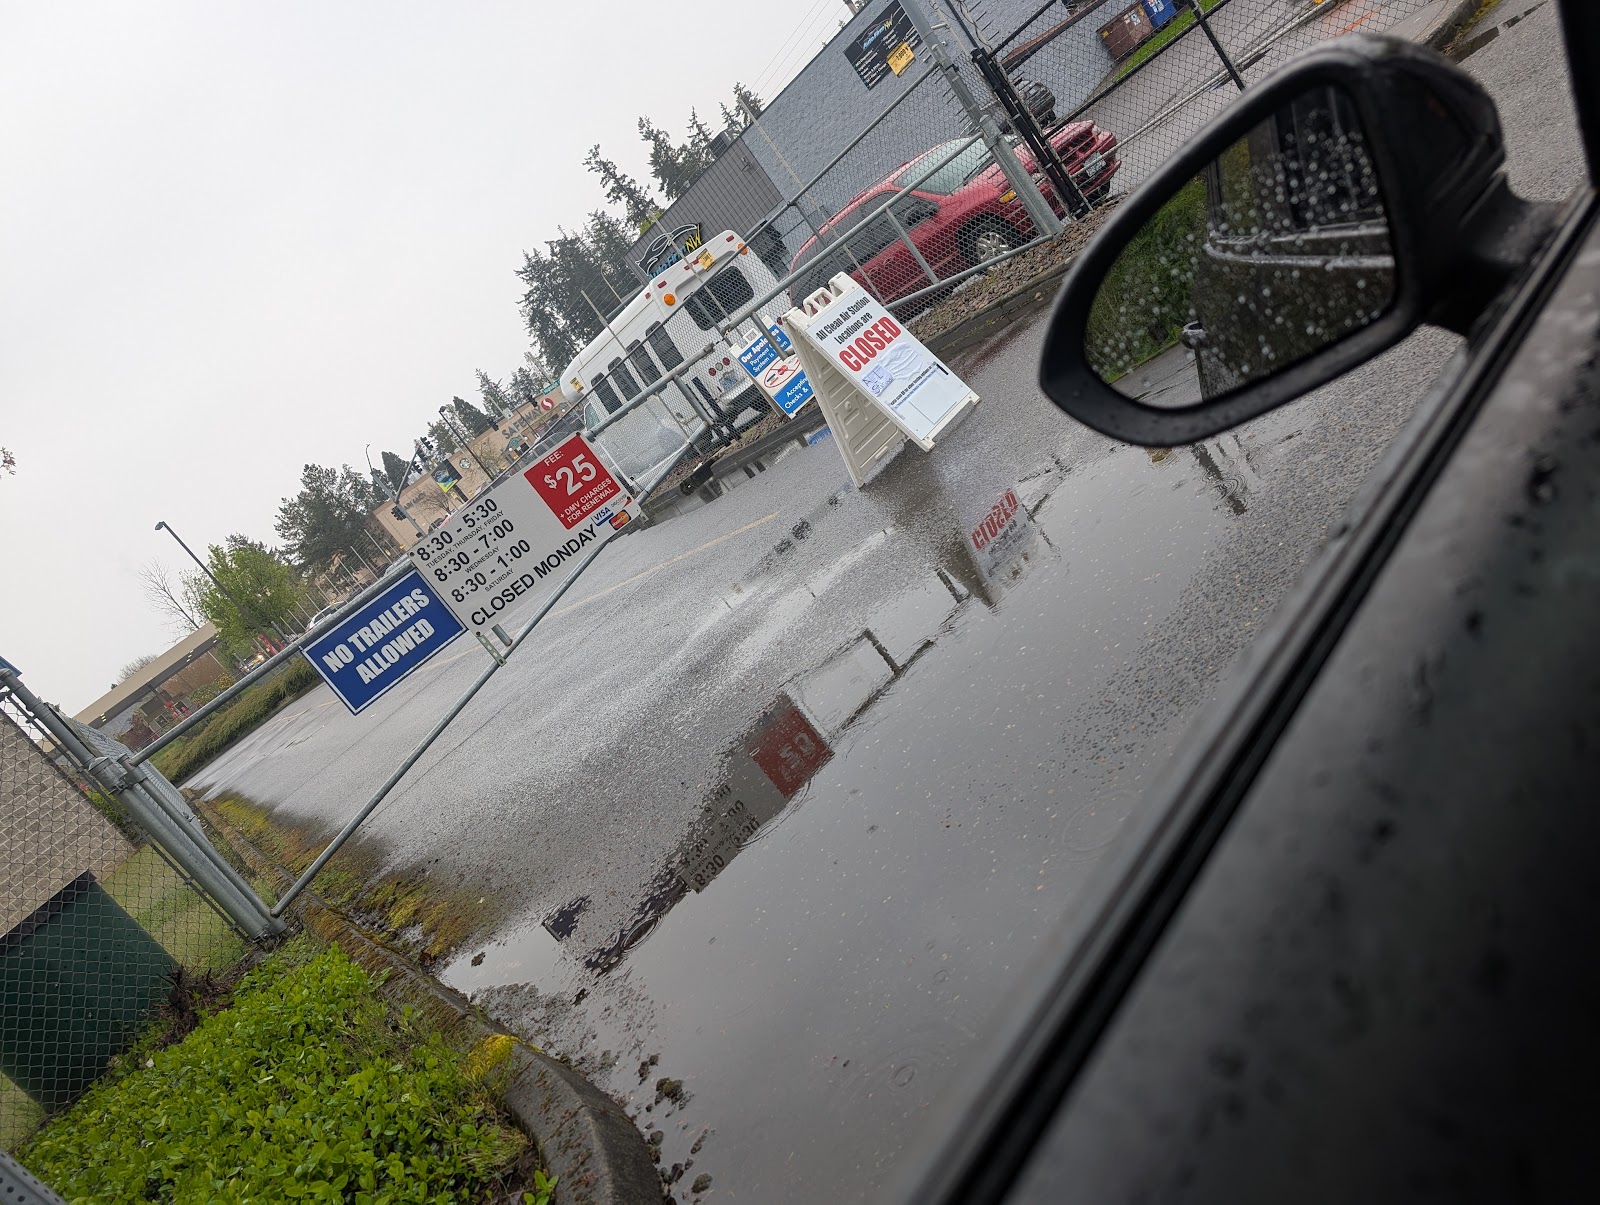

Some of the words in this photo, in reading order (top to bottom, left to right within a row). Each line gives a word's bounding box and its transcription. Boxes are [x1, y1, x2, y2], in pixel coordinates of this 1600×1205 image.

[685, 223, 702, 253] NW
[815, 328, 827, 341] All
[823, 318, 843, 336] Clean
[839, 310, 850, 323] Air
[846, 296, 871, 315] Station
[833, 318, 864, 345] Locations
[863, 312, 873, 324] are
[741, 352, 753, 363] Our
[750, 348, 770, 366] Payment
[839, 317, 902, 372] CLOSED
[753, 357, 770, 373] System
[784, 392, 803, 409] Checks
[543, 450, 564, 467] FEE:
[543, 453, 597, 496] $25
[564, 500, 580, 515] DMV
[580, 477, 612, 504] CHARGES
[566, 510, 583, 523] FOR
[581, 487, 615, 512] RENEWAL
[416, 530, 453, 561] 8:30
[462, 498, 498, 528] 5:30
[483, 510, 504, 527] FRIDAY
[593, 506, 611, 521] VISA
[434, 551, 470, 582] 8:30
[478, 519, 514, 549] 7:00
[465, 546, 500, 574] WEDNESDAY
[451, 572, 487, 603] 8:30
[497, 539, 531, 568] 1:00
[471, 573, 535, 626] CLOSED
[539, 523, 598, 578] MONDAY
[484, 568, 515, 592] SATURDAY
[321, 643, 355, 674] NO
[347, 588, 430, 653] TRAILERS
[355, 618, 435, 685] ALLOWED
